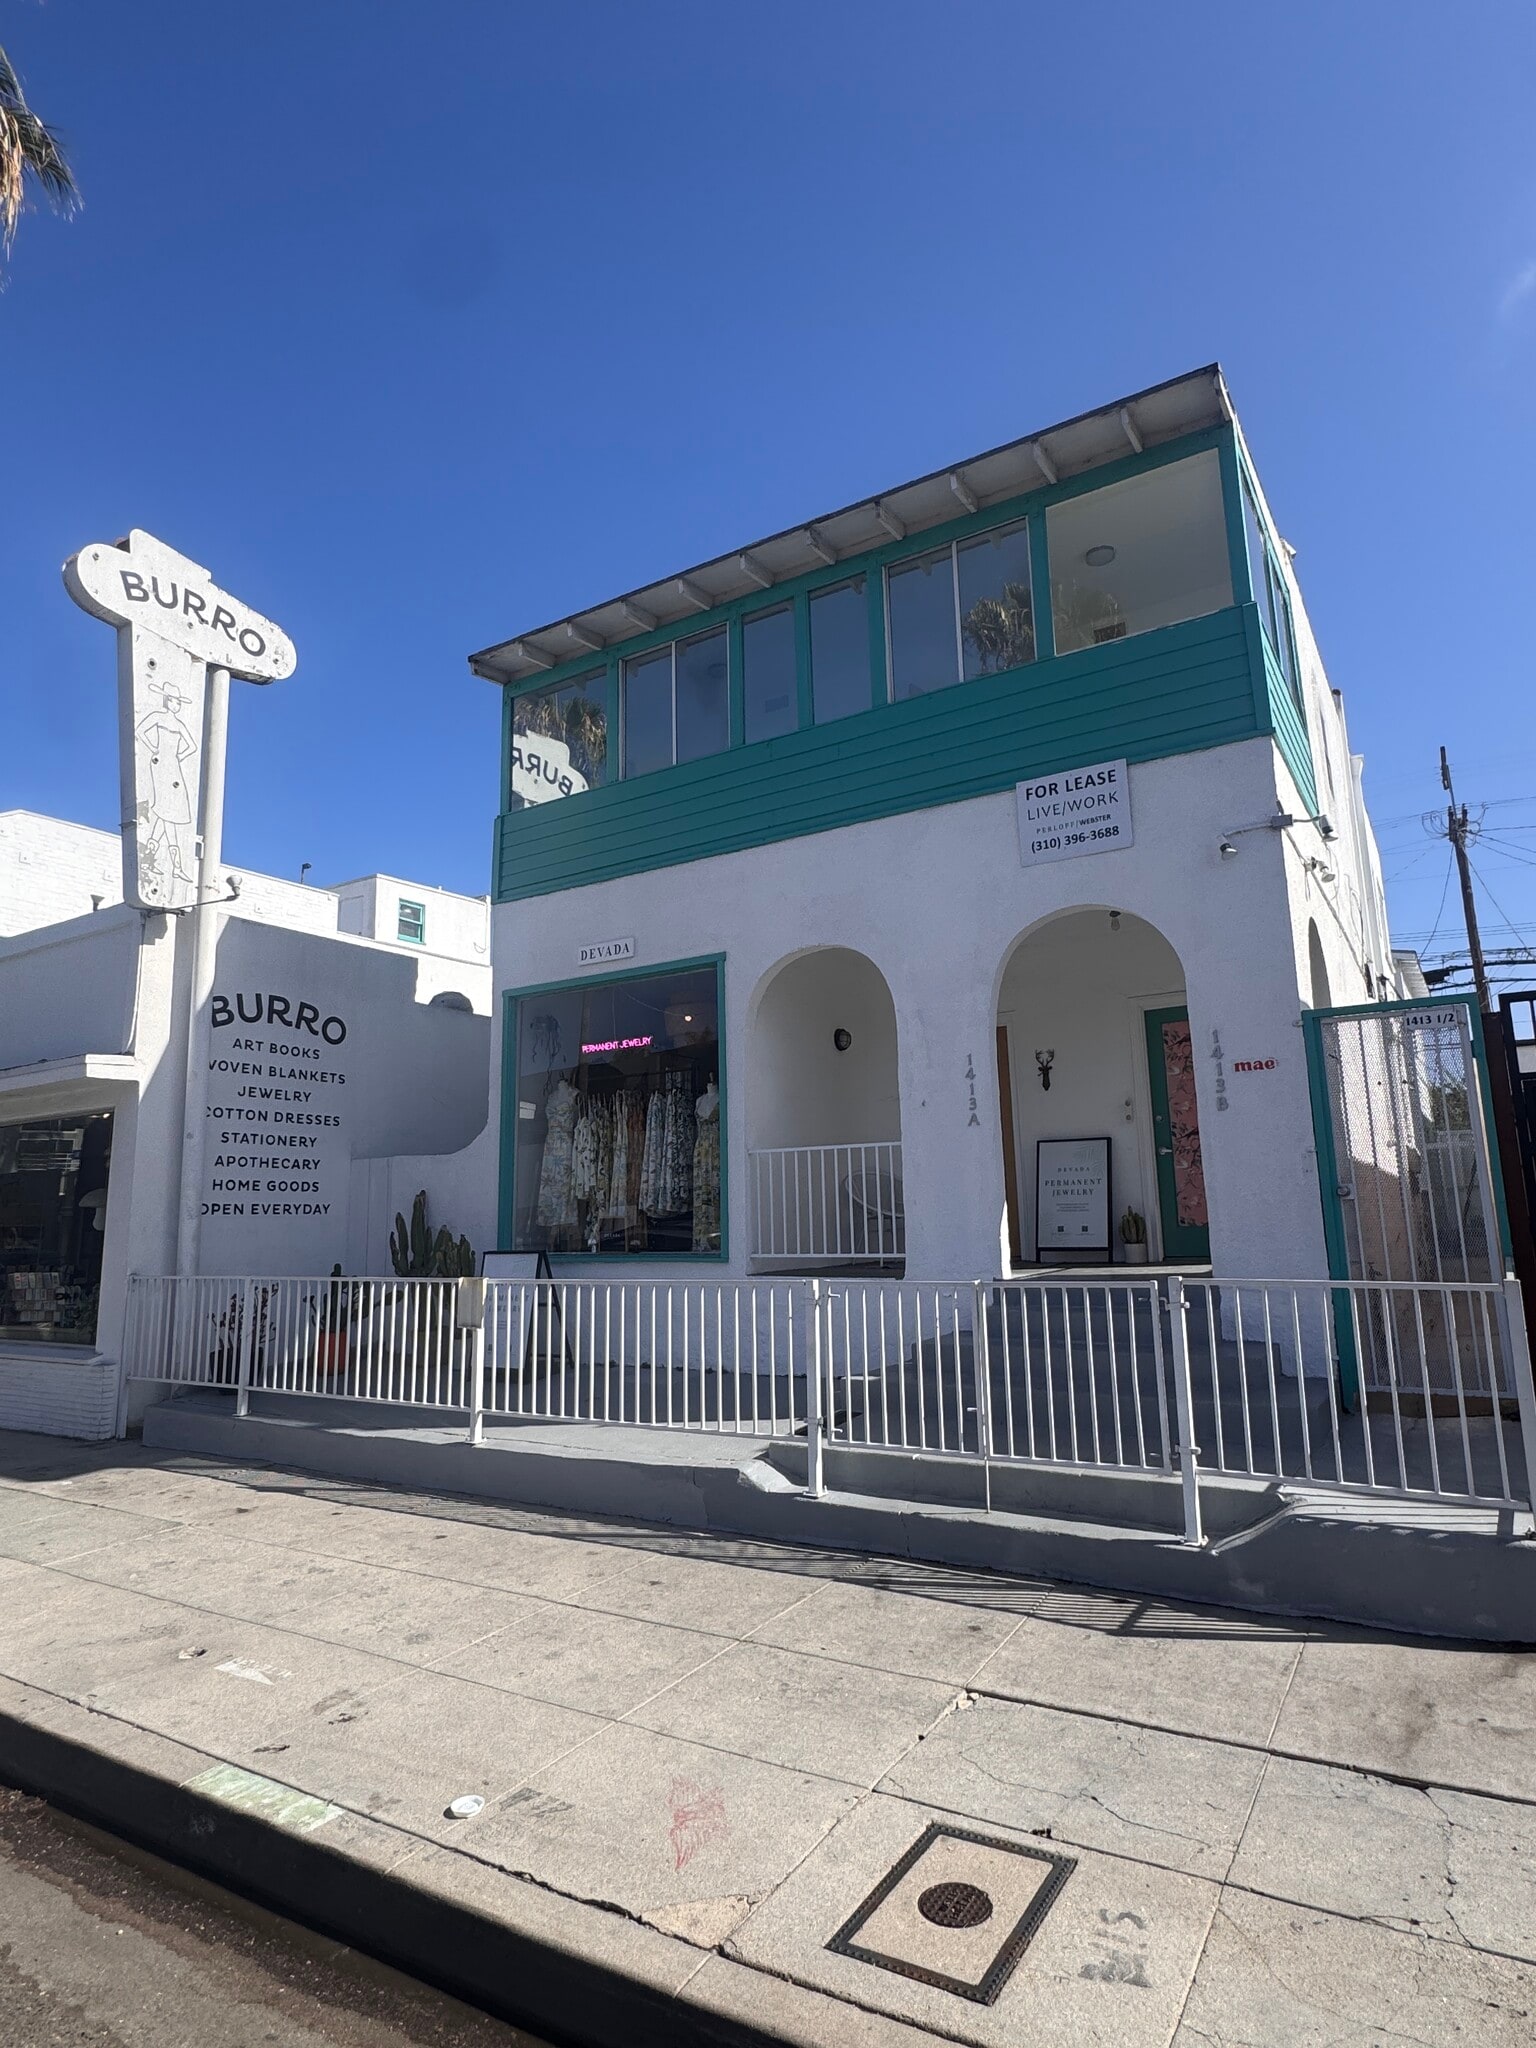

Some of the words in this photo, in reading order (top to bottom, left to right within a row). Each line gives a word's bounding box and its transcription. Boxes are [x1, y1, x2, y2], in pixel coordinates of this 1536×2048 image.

[119, 569, 266, 657] BURRO
[1025, 782, 1059, 801] FOR
[1065, 769, 1117, 793] LEASE
[1027, 791, 1119, 821] LIVE/WORK
[1031, 836, 1061, 853] (310)
[1064, 825, 1120, 846] 396-3688
[580, 942, 630, 961] DEVADA
[211, 993, 347, 1045] BURRO
[1405, 1014, 1432, 1026] 1413
[1436, 1012, 1455, 1024] 1/2
[232, 1038, 264, 1052] ART
[269, 1043, 320, 1060] BOOKS
[581, 1040, 620, 1054] PERMANENT
[620, 1036, 653, 1049] JEWELRY
[1234, 1056, 1277, 1073] mae
[268, 1065, 346, 1084] BLANKETS
[237, 1085, 312, 1102] JEWELRY
[964, 1053, 981, 1127] 1413A
[274, 1111, 341, 1127] DRESSES
[220, 1132, 318, 1148] STATIONERY
[214, 1155, 321, 1170] APOTHECARY
[212, 1179, 261, 1192] HOME
[266, 1180, 320, 1193] GOODS
[1044, 1178, 1102, 1187] PERMANENT
[1052, 1188, 1094, 1197] JEWELRY
[201, 1203, 245, 1215] OPEN
[251, 1203, 331, 1215] EVERYDAY
